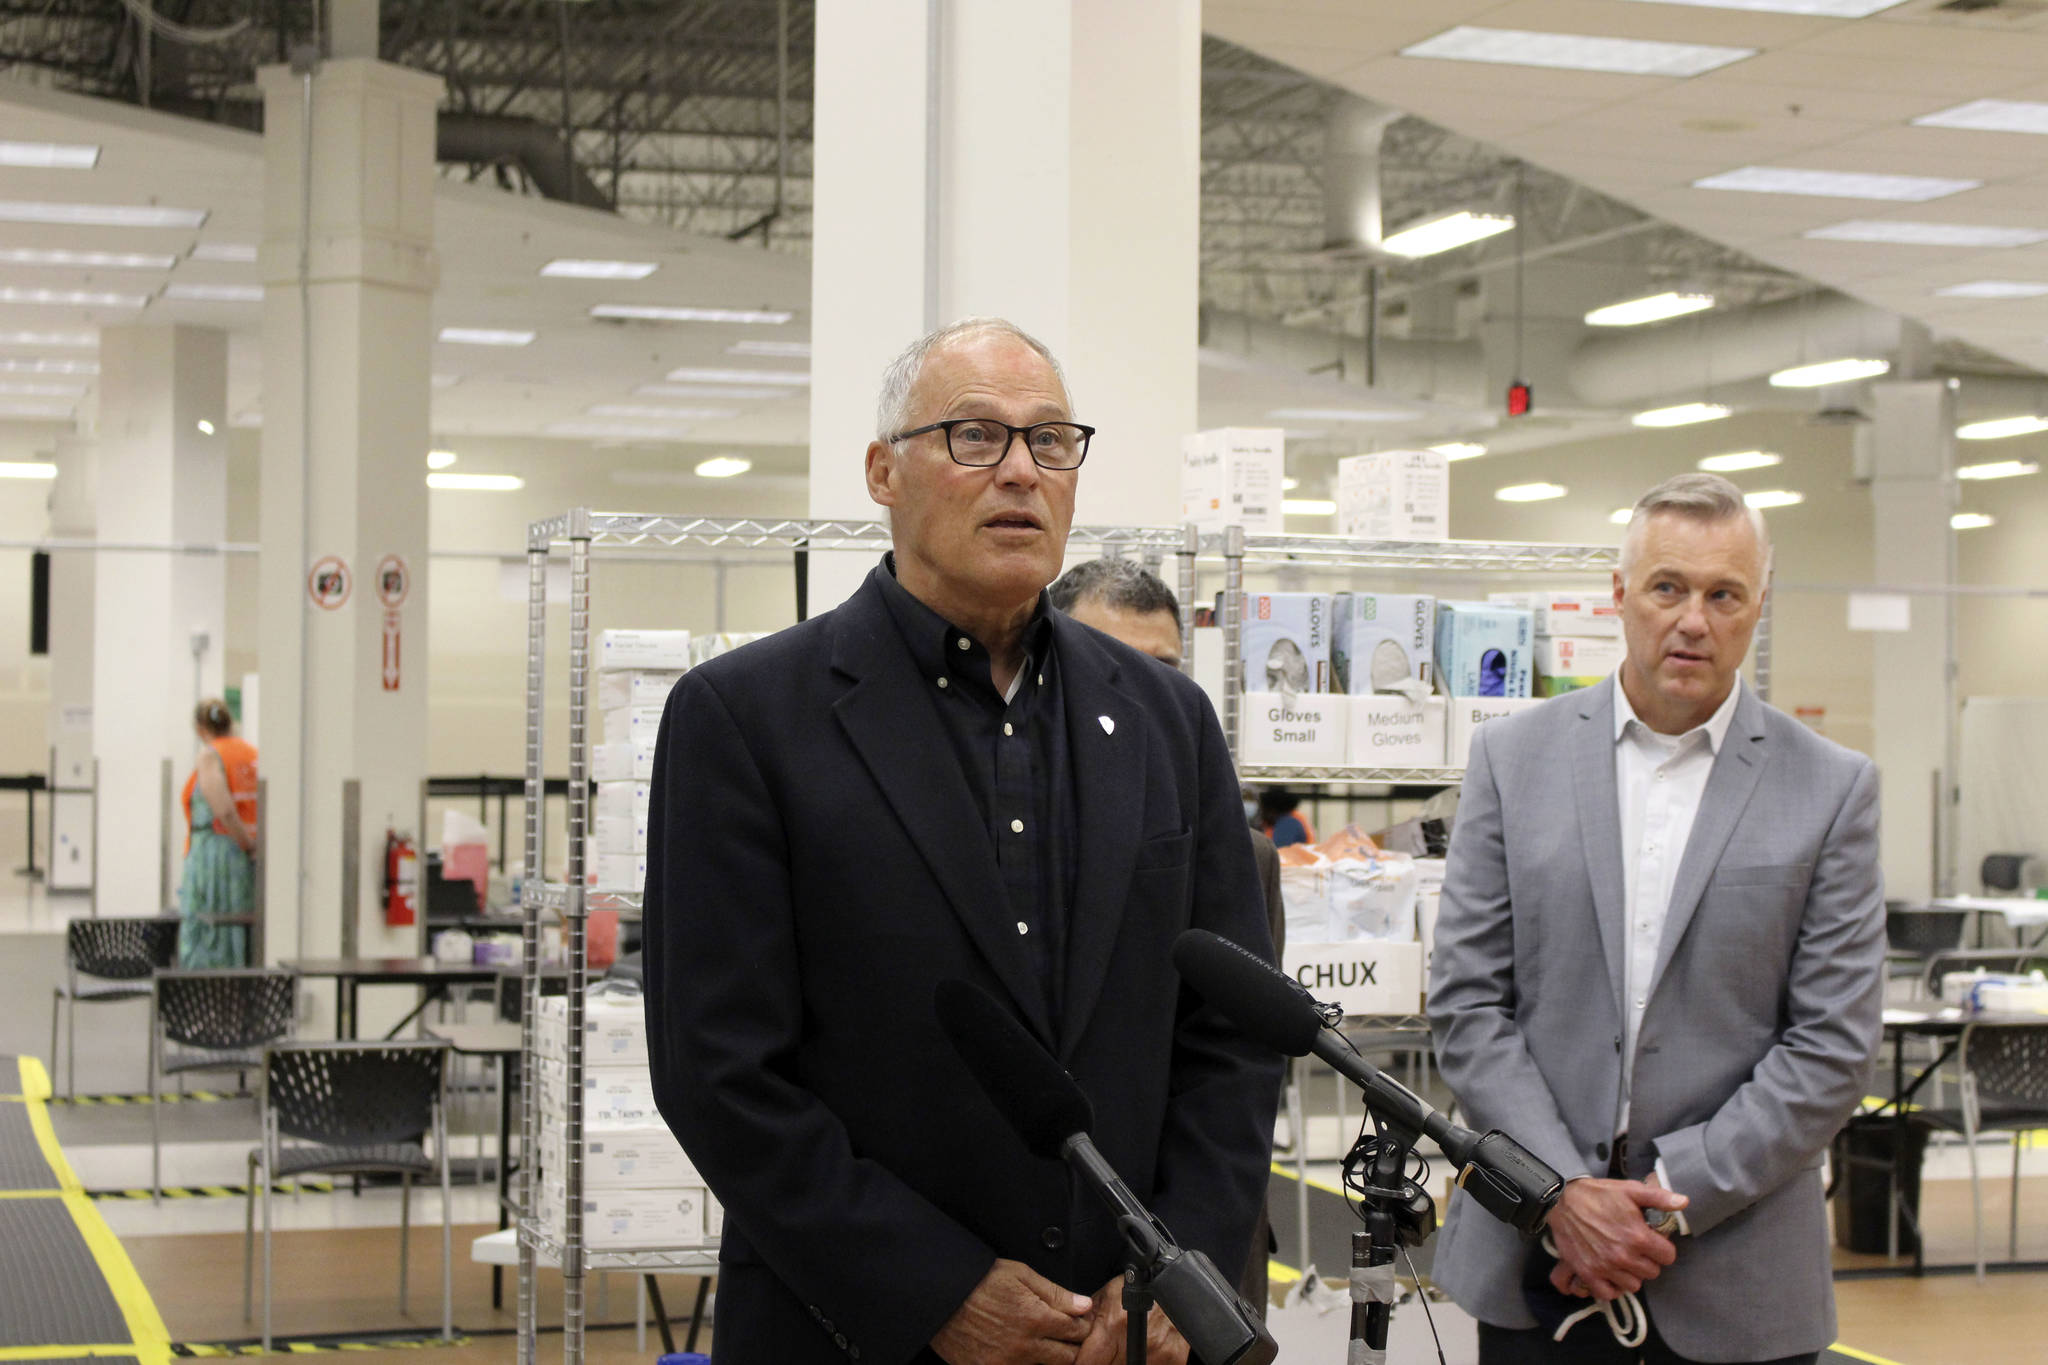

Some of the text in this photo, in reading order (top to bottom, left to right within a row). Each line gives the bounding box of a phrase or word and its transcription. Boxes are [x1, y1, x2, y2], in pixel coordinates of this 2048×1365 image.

[1311, 597, 1321, 648] GLOVES
[1415, 599, 1425, 650] GLOVES
[1268, 708, 1322, 723] Gloves
[1368, 711, 1425, 726] Medium
[1273, 728, 1316, 743] Small
[1372, 732, 1422, 747] Gloves
[1217, 936, 1284, 978] SENNHEISER
[1297, 961, 1378, 989] CHUX
